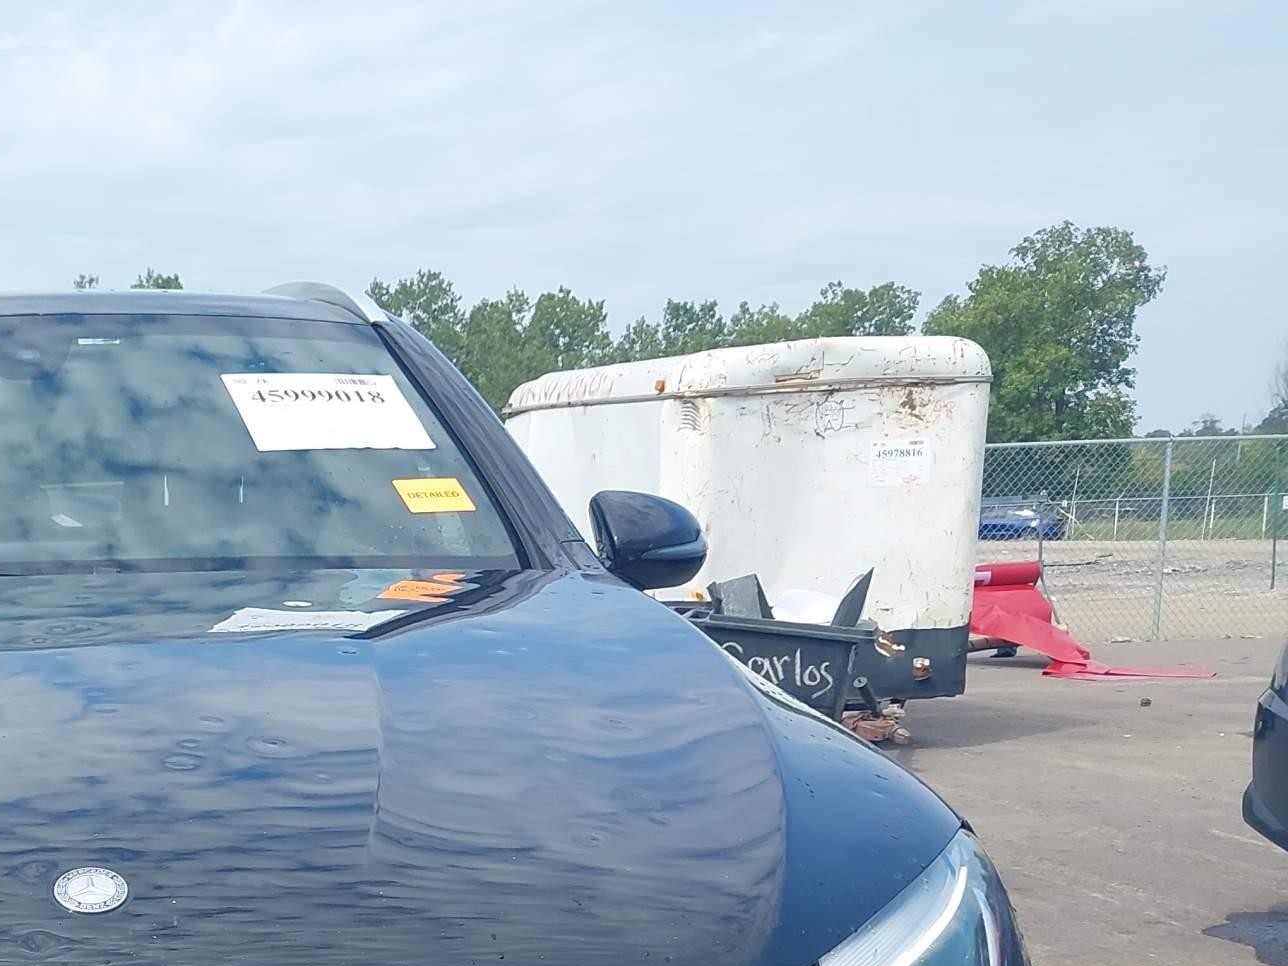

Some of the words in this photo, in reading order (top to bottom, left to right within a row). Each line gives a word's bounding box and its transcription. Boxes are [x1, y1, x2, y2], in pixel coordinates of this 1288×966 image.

[251, 389, 386, 403] 45999018
[875, 447, 924, 459] 45978816
[407, 490, 460, 499] DETAILED
